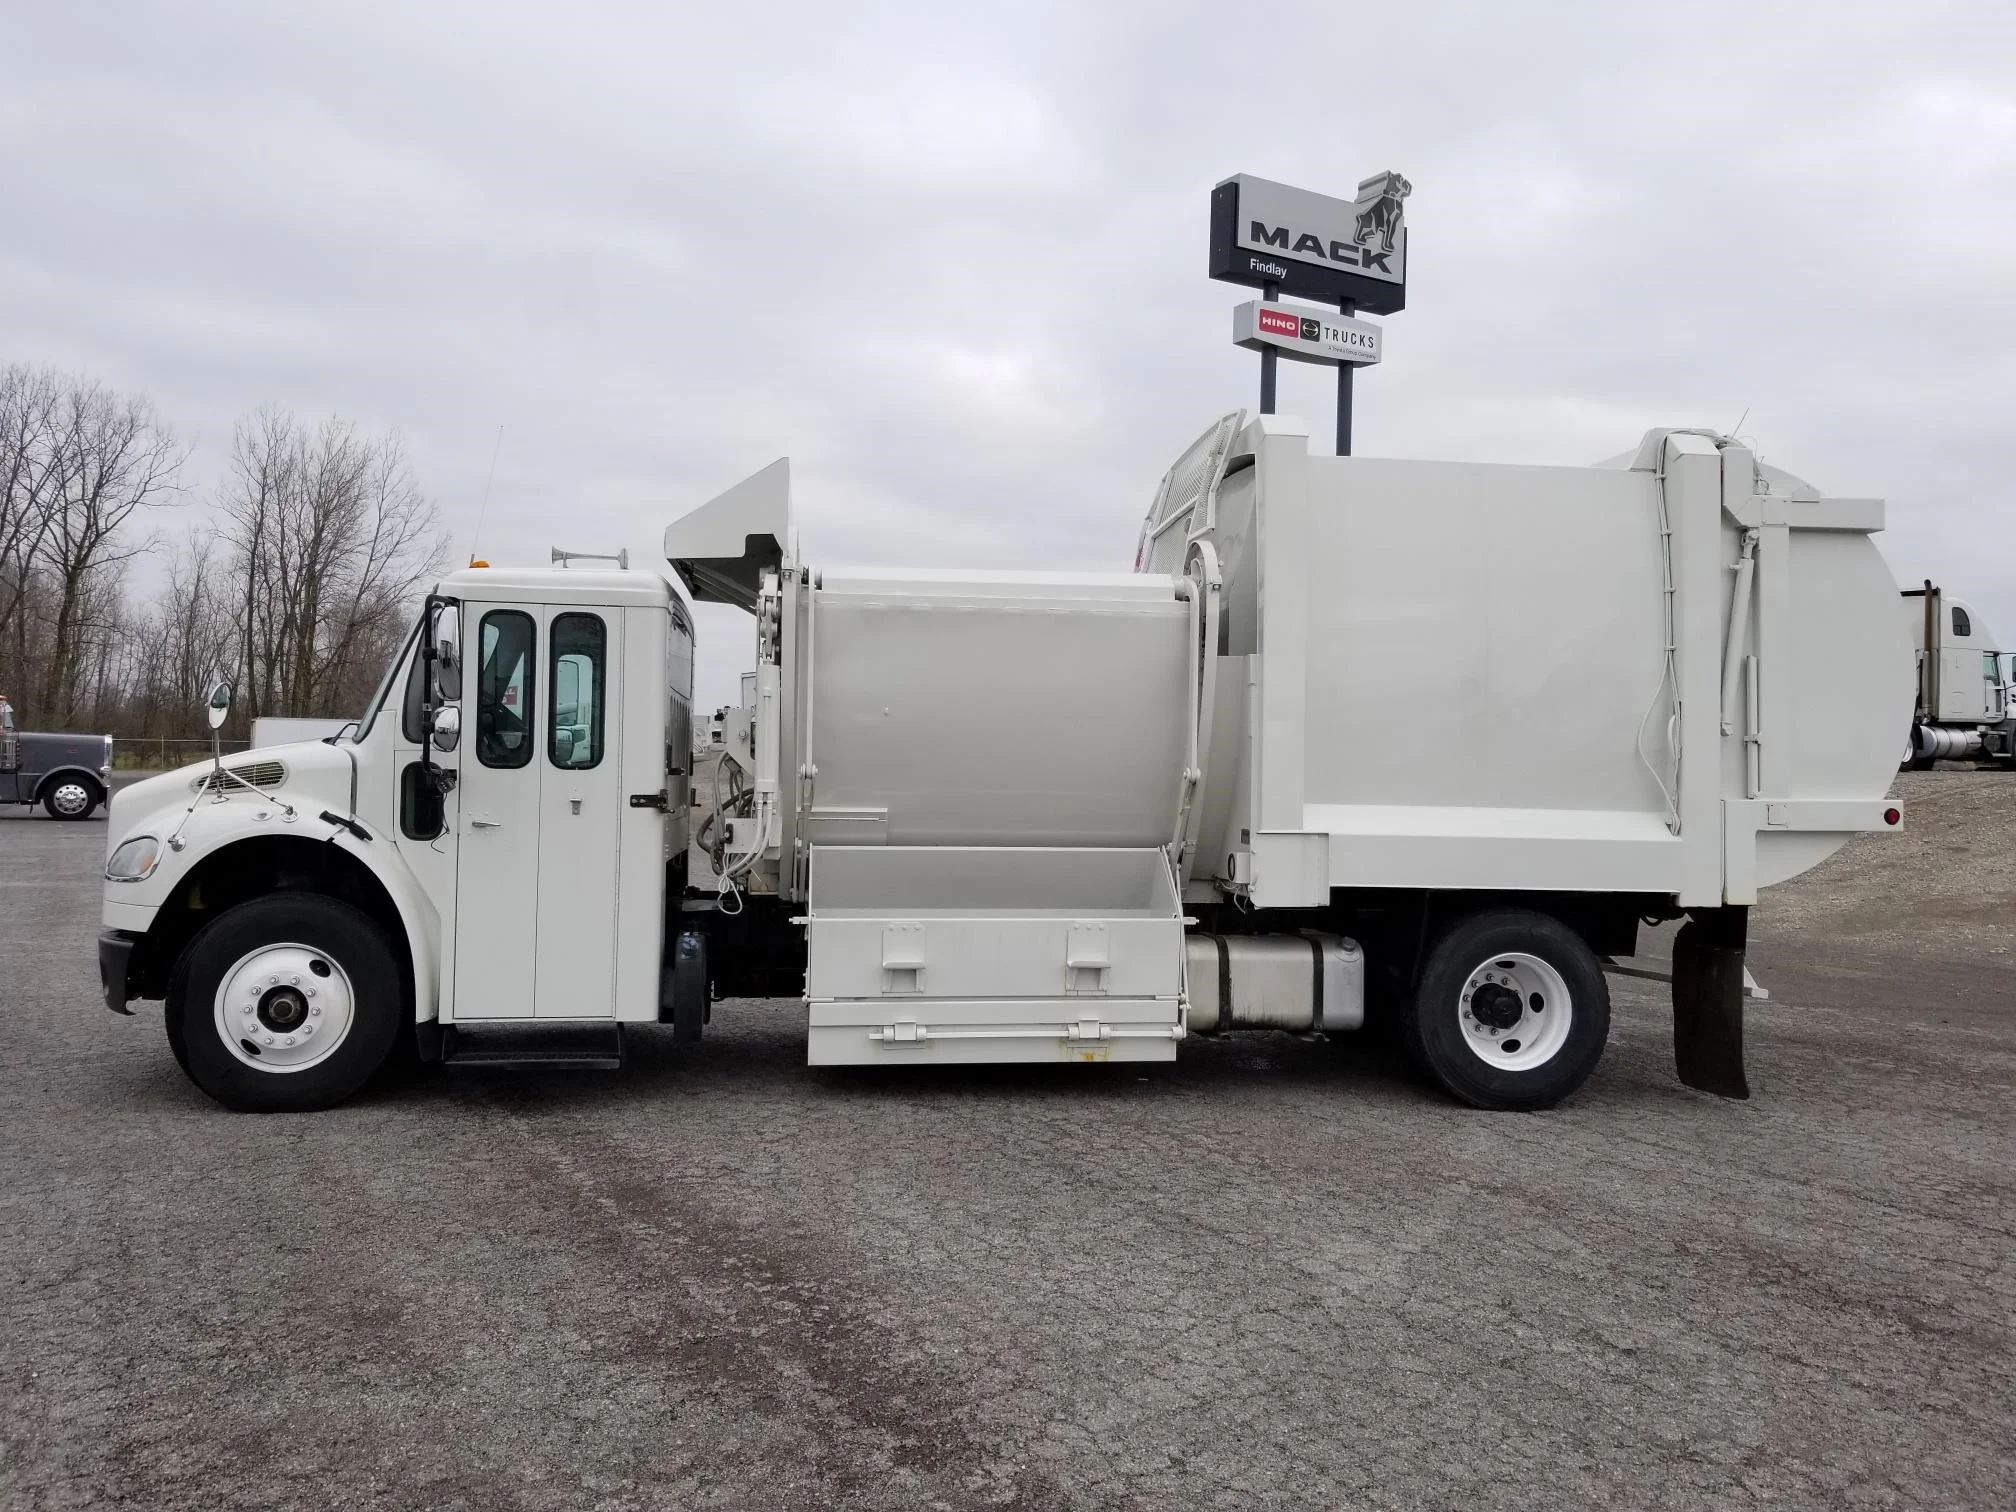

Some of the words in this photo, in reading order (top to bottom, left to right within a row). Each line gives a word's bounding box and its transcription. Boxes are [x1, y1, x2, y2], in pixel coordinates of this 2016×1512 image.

[1251, 220, 1393, 275] MACK
[1250, 258, 1287, 279] Findlay
[1262, 317, 1296, 331] HINO
[1324, 327, 1374, 349] TRUCKS
